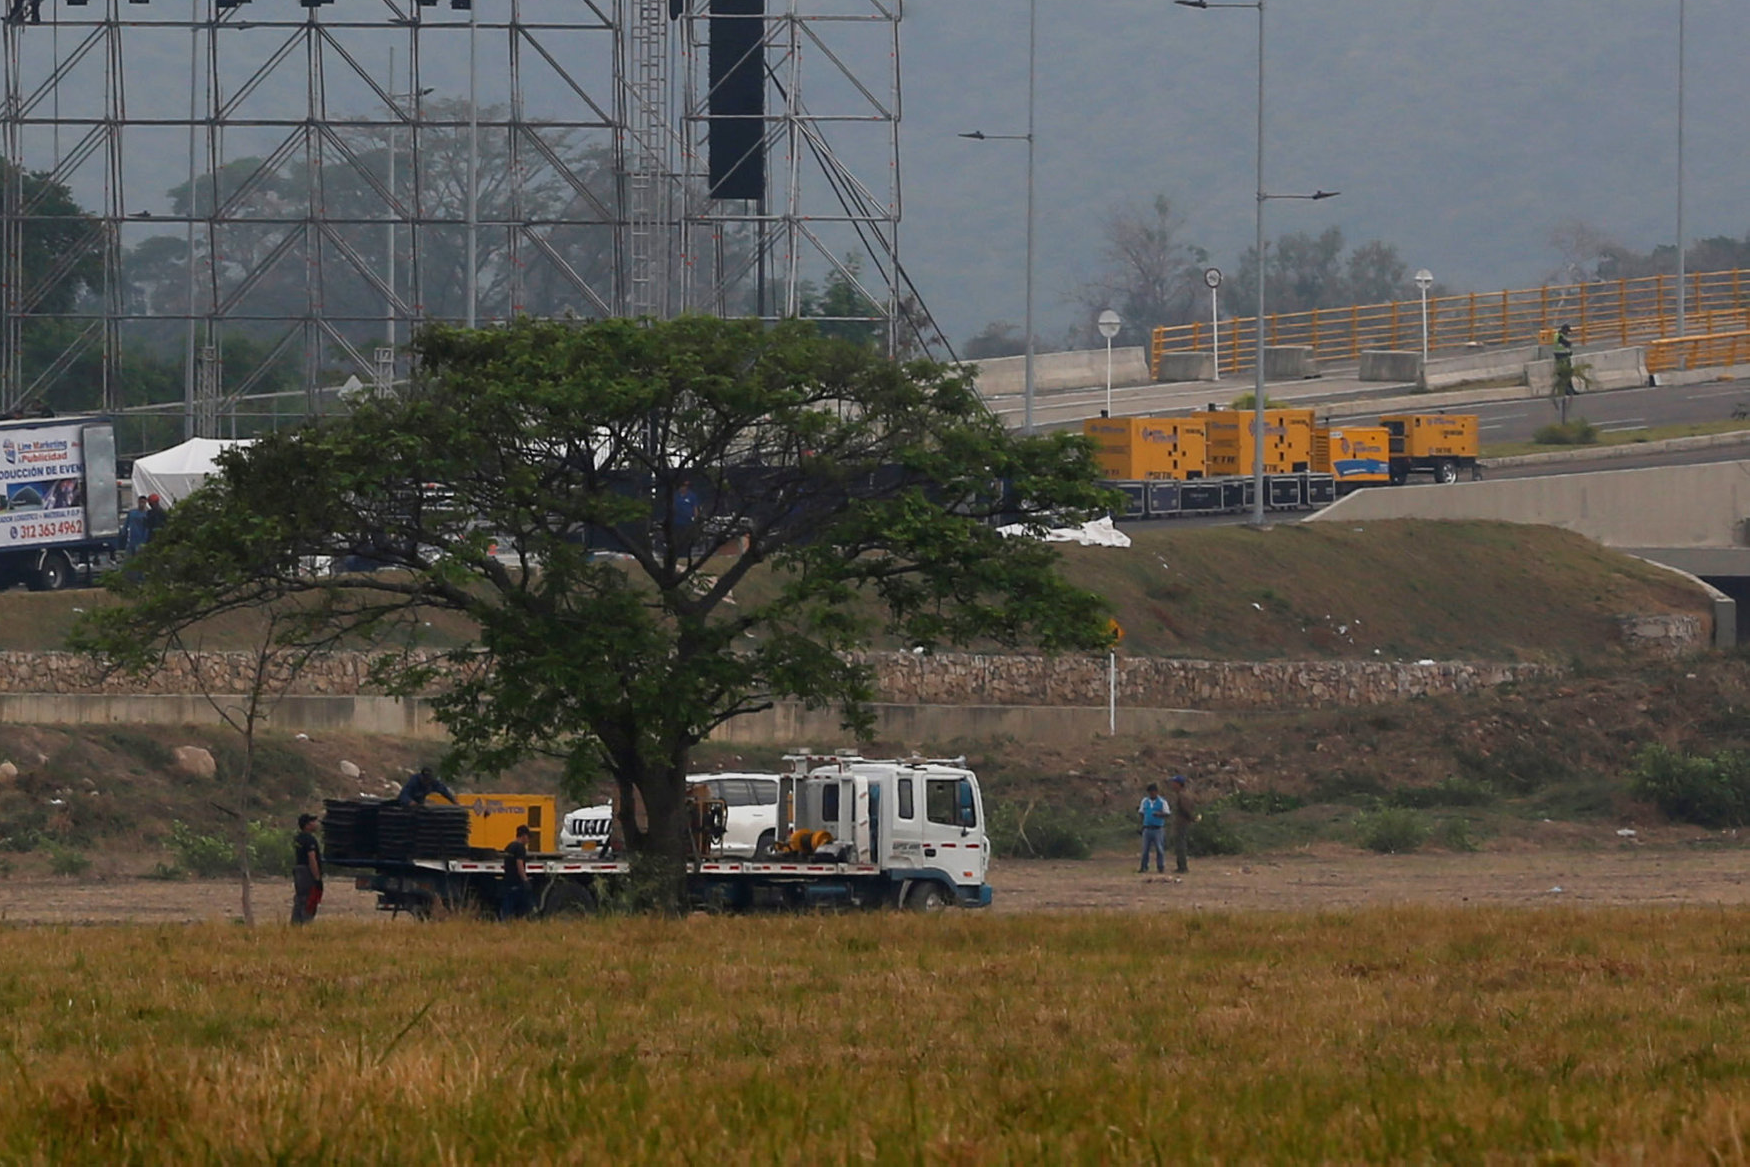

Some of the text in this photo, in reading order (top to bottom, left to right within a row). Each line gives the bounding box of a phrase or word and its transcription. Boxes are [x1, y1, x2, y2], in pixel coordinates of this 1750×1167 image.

[17, 442, 32, 451] Line
[33, 440, 68, 450] Marketing
[22, 451, 68, 463] Publicidad
[46, 465, 57, 475] DE
[20, 519, 83, 539] 312 363 4962
